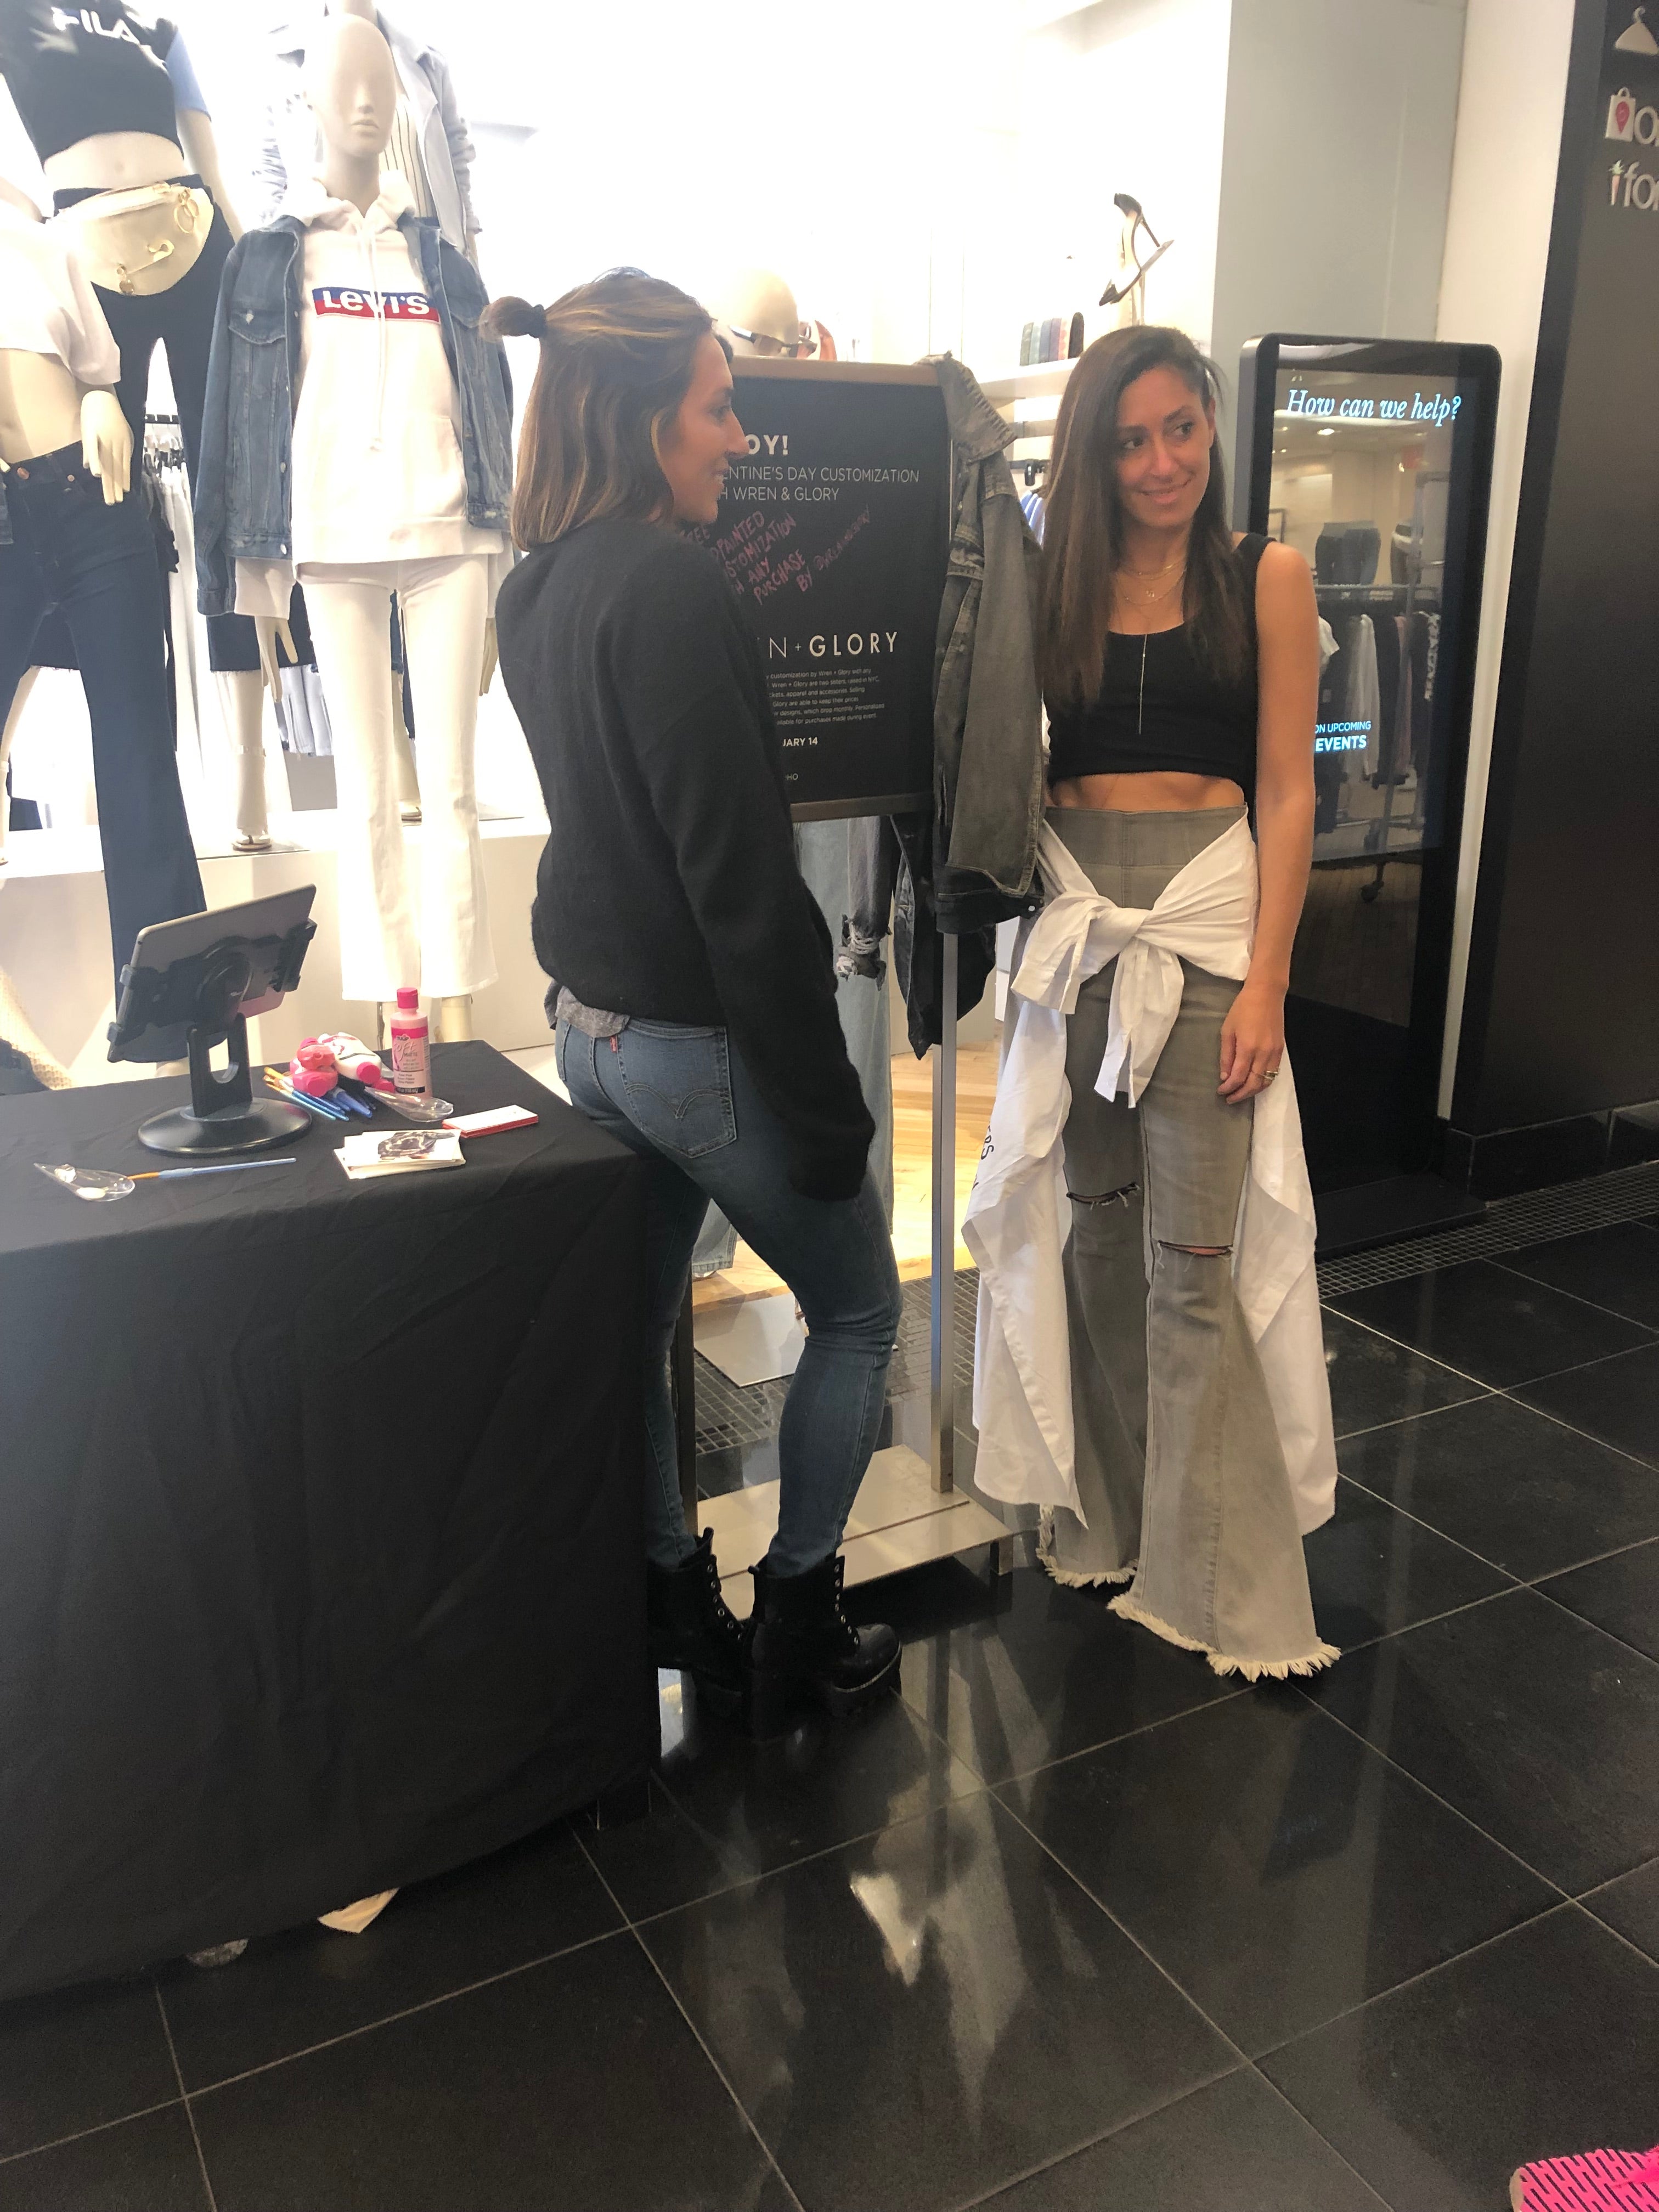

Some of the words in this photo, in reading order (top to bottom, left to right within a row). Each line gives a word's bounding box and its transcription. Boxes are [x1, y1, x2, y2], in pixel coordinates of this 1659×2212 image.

[51, 7, 140, 44] FILA
[1634, 106, 1659, 147] o
[1286, 390, 1335, 416] How
[1340, 398, 1374, 417] can
[1380, 400, 1407, 419] we
[1410, 393, 1462, 426] help?
[788, 467, 816, 481] DAY
[821, 467, 919, 483] CUSTOMIZATION
[733, 487, 777, 500] WREN
[781, 487, 791, 500] &
[794, 487, 839, 501] GLORY
[748, 556, 770, 583] ANY
[754, 549, 805, 606] PURCHASE
[796, 566, 812, 592] BY
[809, 631, 898, 657] GLORY
[1328, 720, 1371, 732] UPCOMING
[808, 737, 818, 746] 14
[1315, 735, 1367, 752] EVENTS
